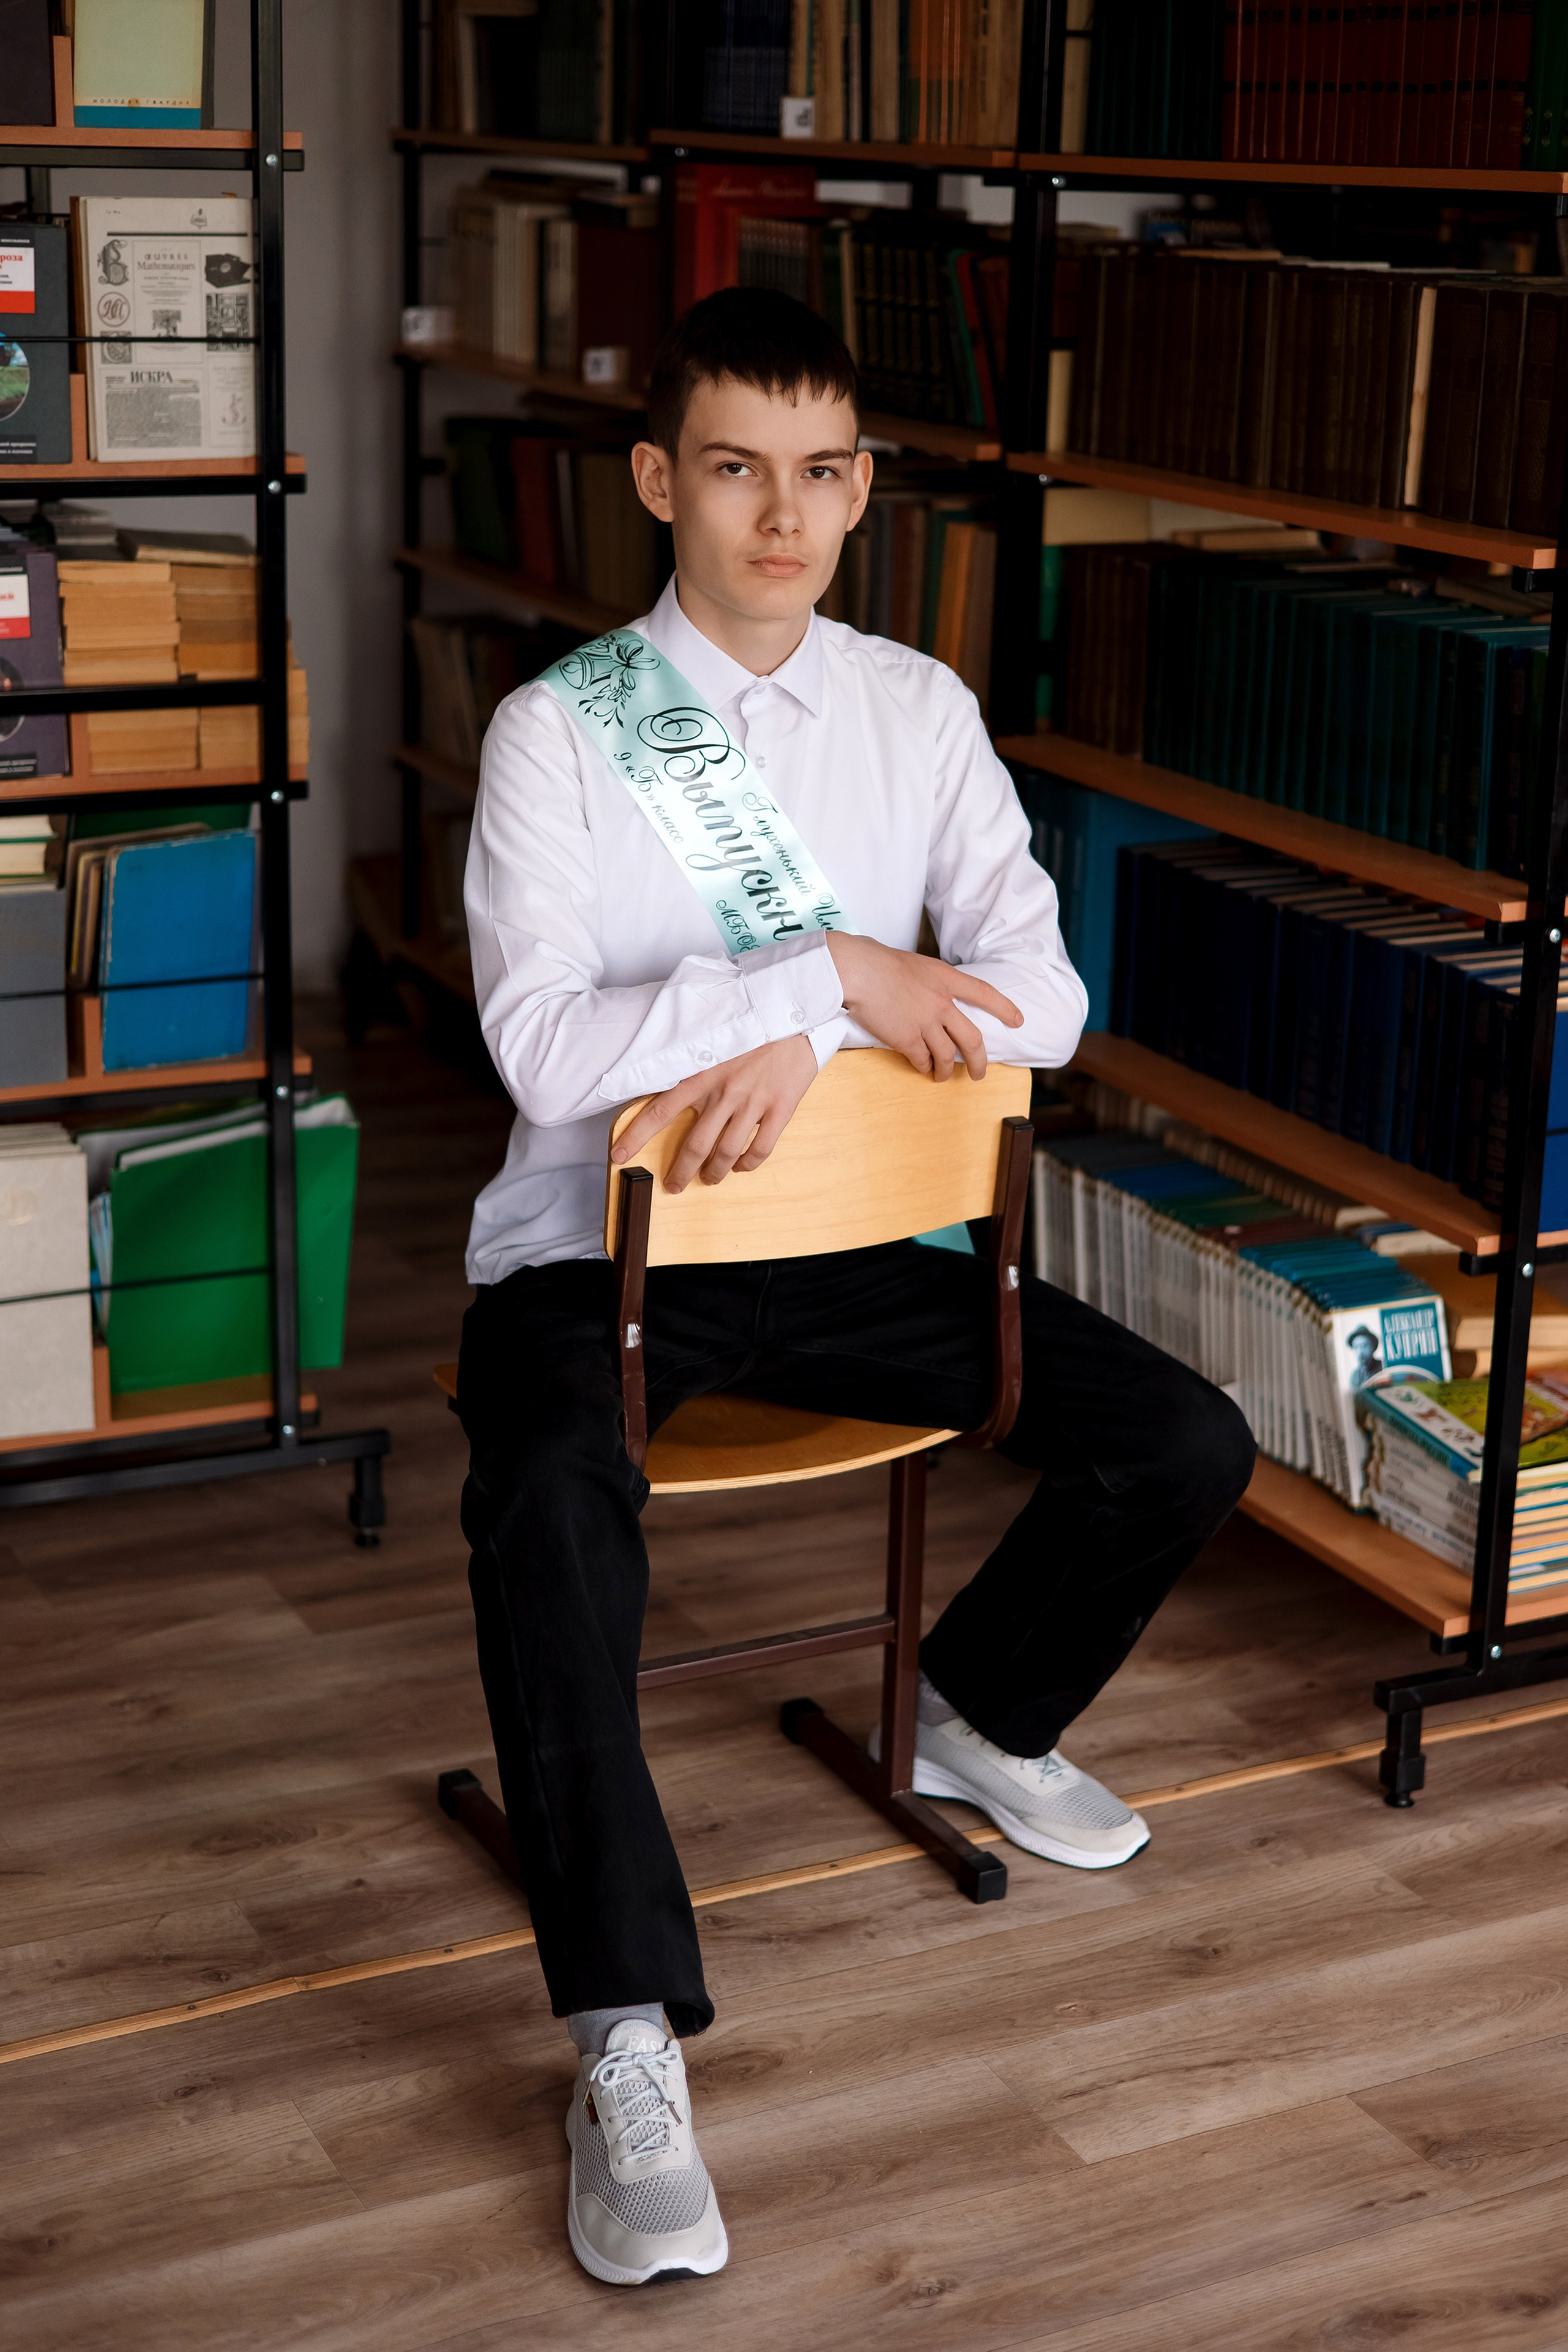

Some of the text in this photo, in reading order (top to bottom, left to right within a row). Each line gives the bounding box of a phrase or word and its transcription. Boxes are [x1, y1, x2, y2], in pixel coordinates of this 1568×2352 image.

[130, 371, 173, 383] ИСКРА
[613, 752, 632, 761] 9
[651, 805, 684, 843] класс
[742, 792, 841, 930] Глухенький Ил
[1384, 1308, 1434, 1333] АЛЕКСАНДР
[1385, 1327, 1439, 1361] КУПРИН
